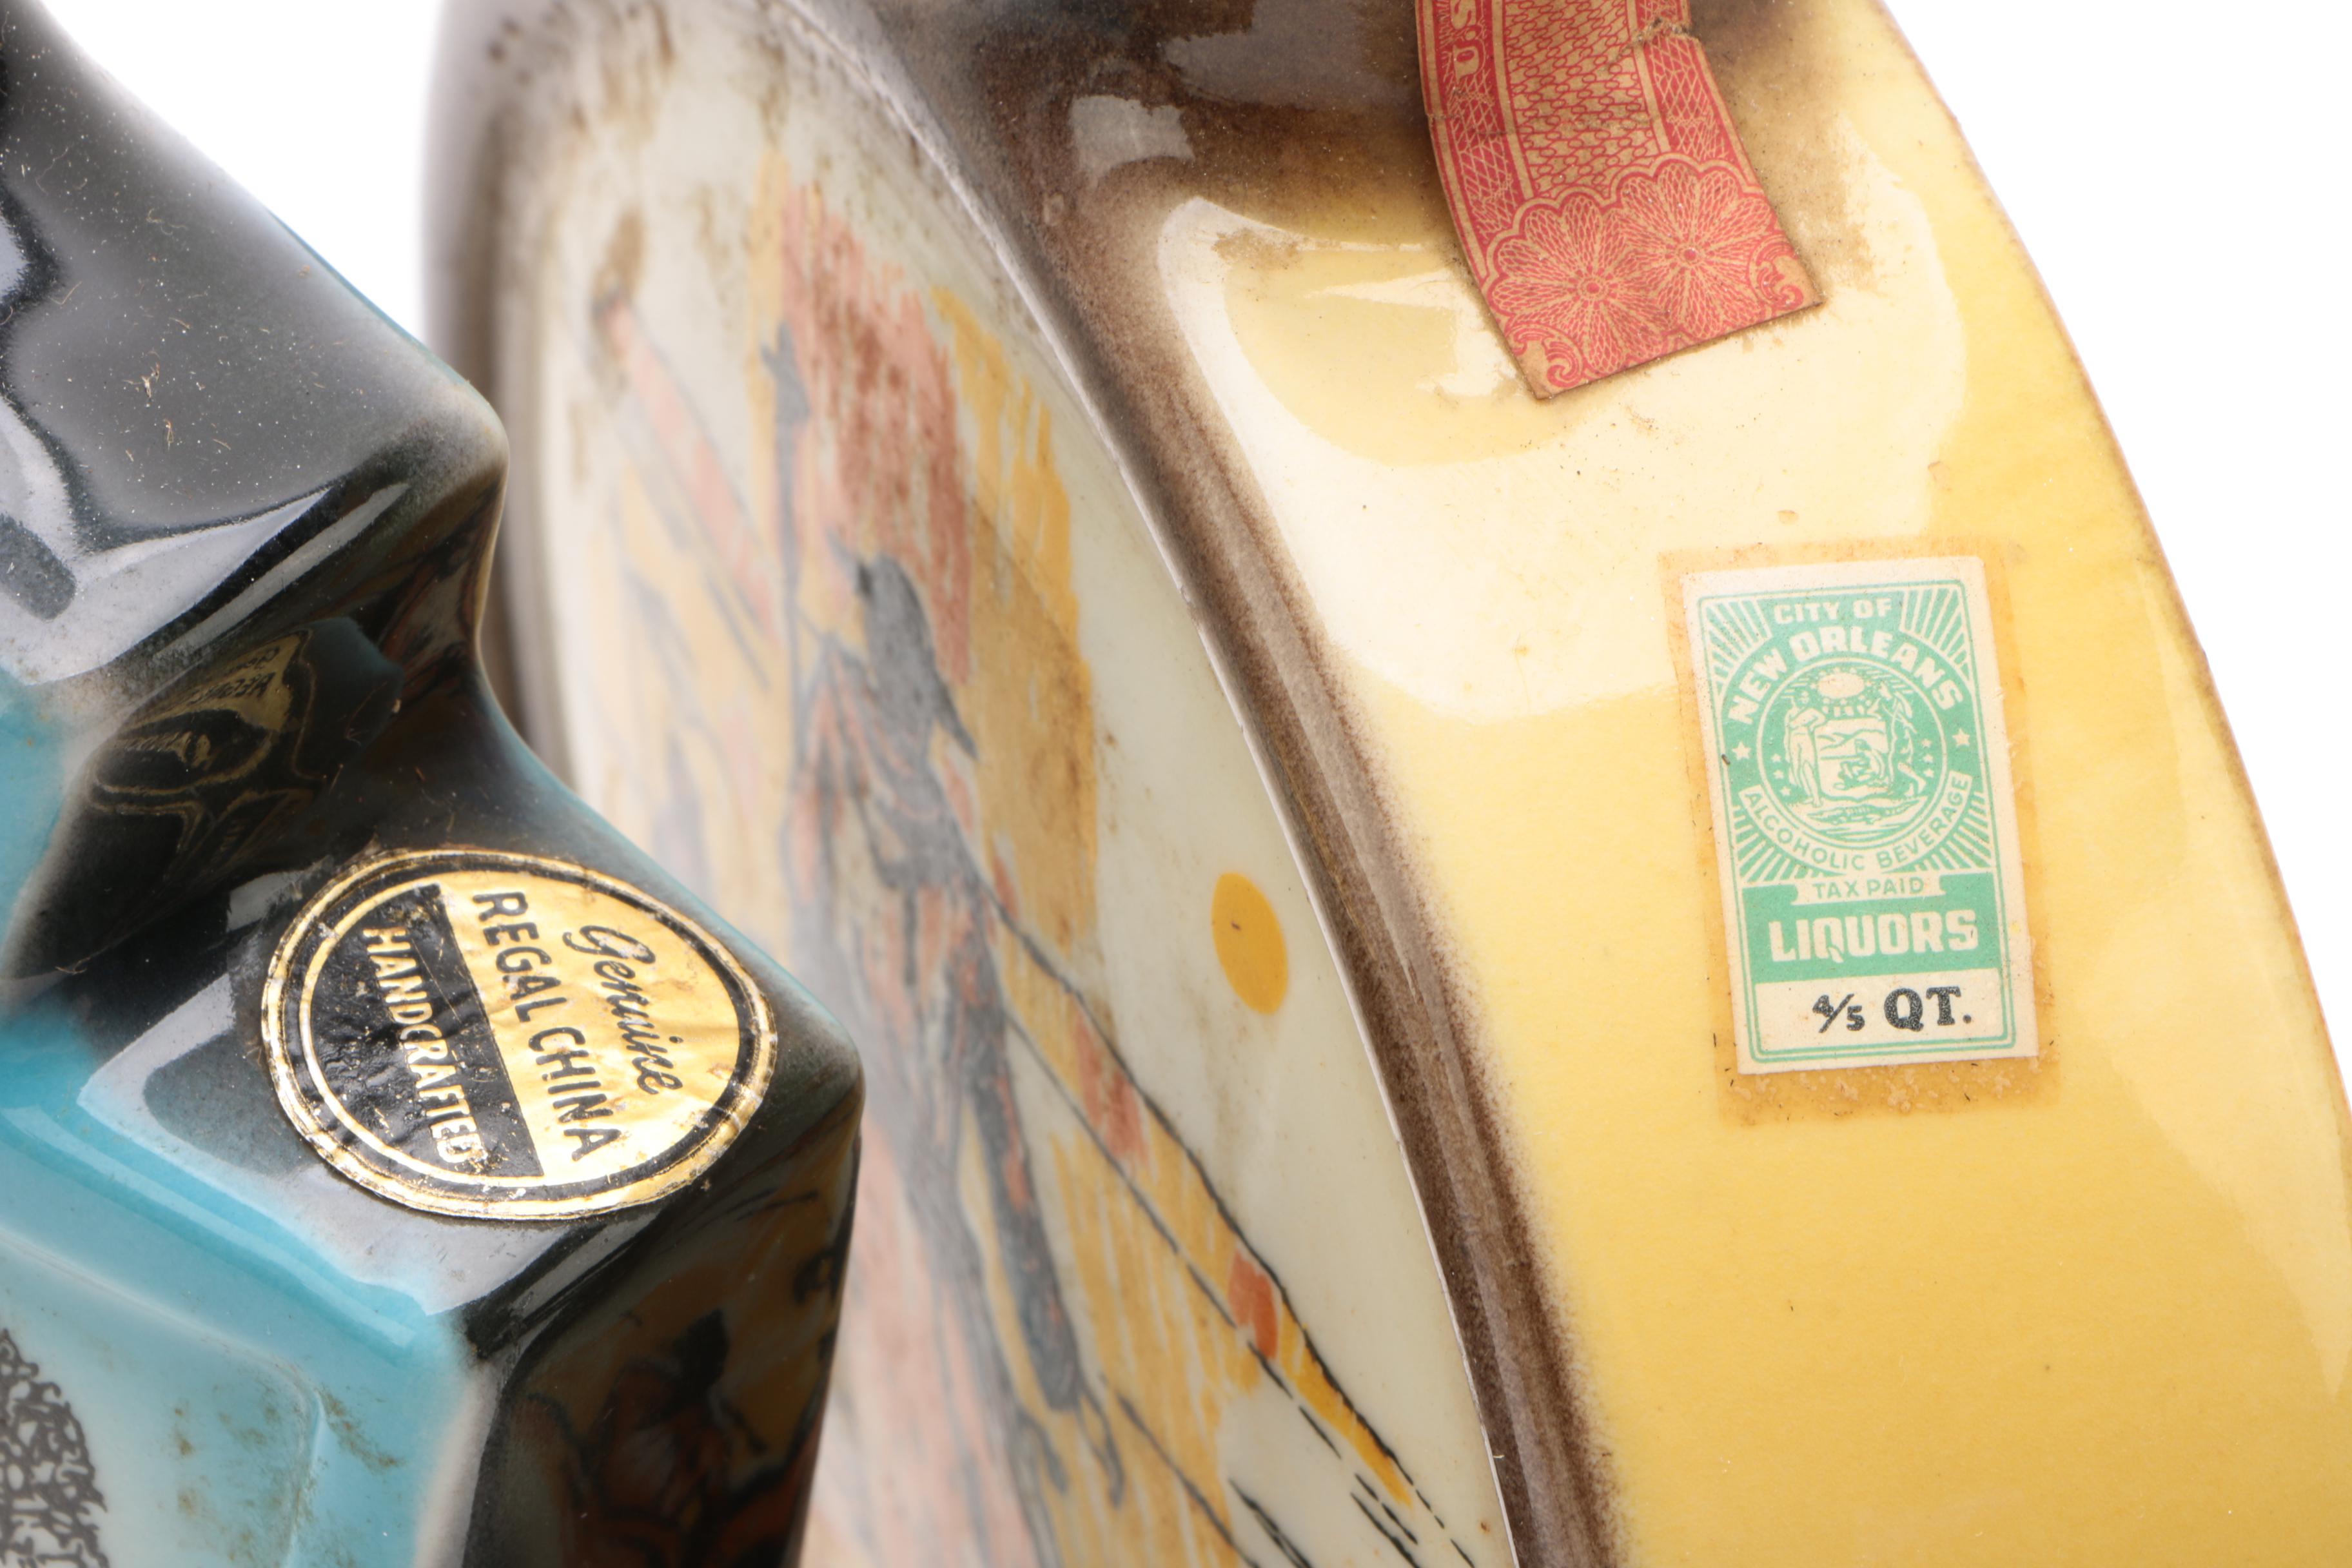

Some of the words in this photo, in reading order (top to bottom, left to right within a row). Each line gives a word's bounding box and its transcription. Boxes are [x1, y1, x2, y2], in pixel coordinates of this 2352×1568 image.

[1773, 599, 1839, 623] CITY
[1854, 598, 1892, 620] OF
[1727, 649, 1787, 725] NEW
[1790, 629, 1964, 710] ORLEANS
[1745, 791, 1865, 870] ALCOHOLIC
[1877, 777, 1967, 870] BEVERAGE
[1812, 880, 1859, 898] TAX
[1866, 877, 1924, 896] PAID
[1768, 909, 1978, 963] LIQUORS
[362, 926, 484, 1164] HANDCRAFTED
[472, 892, 567, 1023] REGAL
[529, 1026, 621, 1162] CHINA
[562, 924, 683, 1095] Genuine
[1812, 992, 1864, 1033] 4/5
[1883, 985, 1971, 1032] QT.
